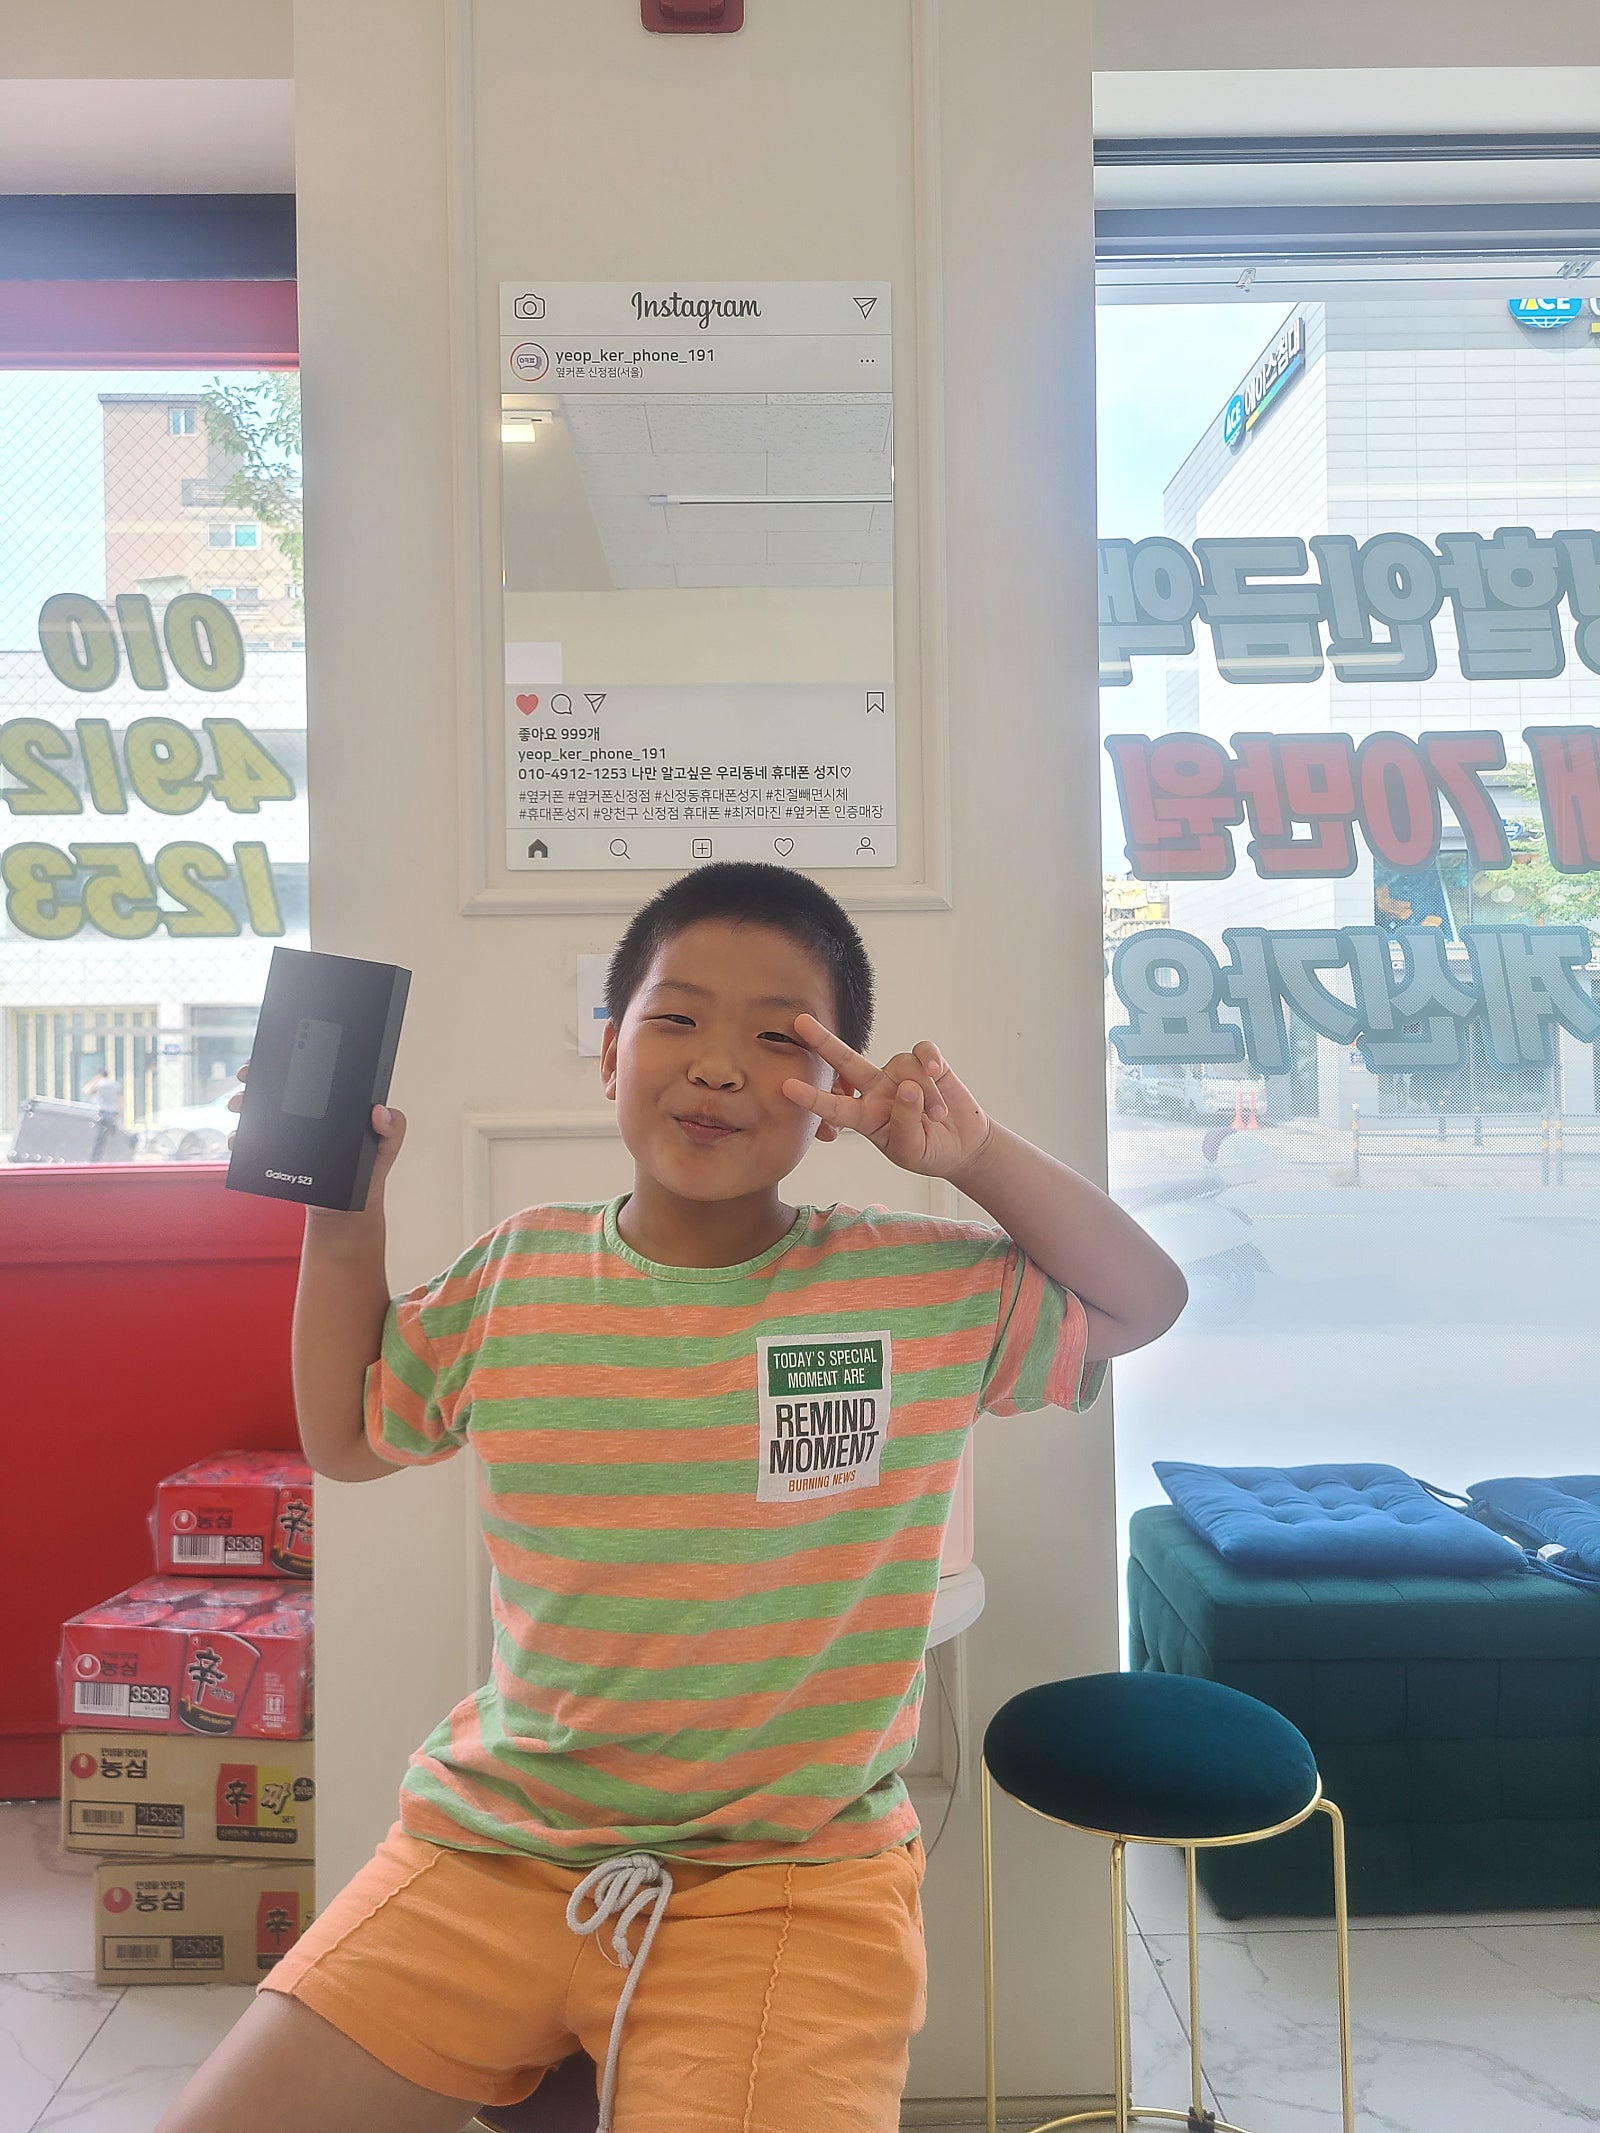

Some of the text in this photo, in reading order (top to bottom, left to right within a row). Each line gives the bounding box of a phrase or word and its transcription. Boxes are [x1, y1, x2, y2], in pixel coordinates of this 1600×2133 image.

[631, 291, 762, 330] Instagram
[556, 349, 714, 364] yeop_ker_phone_191
[556, 367, 643, 378] 옆커폰 신정점(서울)
[1244, 318, 1300, 415] 에이스침대
[518, 727, 600, 741] 좋아요 999개
[518, 748, 666, 762] yeop_ker_phone_191
[518, 768, 627, 780] 010-4912-1253
[631, 766, 657, 780] 나만
[661, 766, 712, 780] 알고싶은
[716, 766, 767, 780] 우리동네
[771, 765, 810, 780] 휴대폰
[519, 787, 848, 803] #옆커폰 #옆커폰신정점 #신정동휴대폰성지 #친절빼면시체
[519, 805, 883, 821] #휴대폰성지 #양천구 신정점 휴대폰 #최저마진 #옆커폰 인증매장
[265, 1169, 313, 1186] Galaxy S23
[830, 1348, 877, 1367] SPECIAL
[788, 1368, 865, 1388] MOMENT ARE
[775, 1397, 876, 1438] REMIND
[769, 1430, 879, 1474] MOMENT
[788, 1470, 856, 1492] BURNING NEWS
[101, 1660, 138, 1677] 농심
[187, 1647, 227, 1704] 辛
[130, 1685, 169, 1704] 3538
[101, 1757, 147, 1779] 농심
[225, 1779, 253, 1819] 辛
[135, 1891, 184, 1912] 농심
[265, 1906, 294, 1945] 辛
